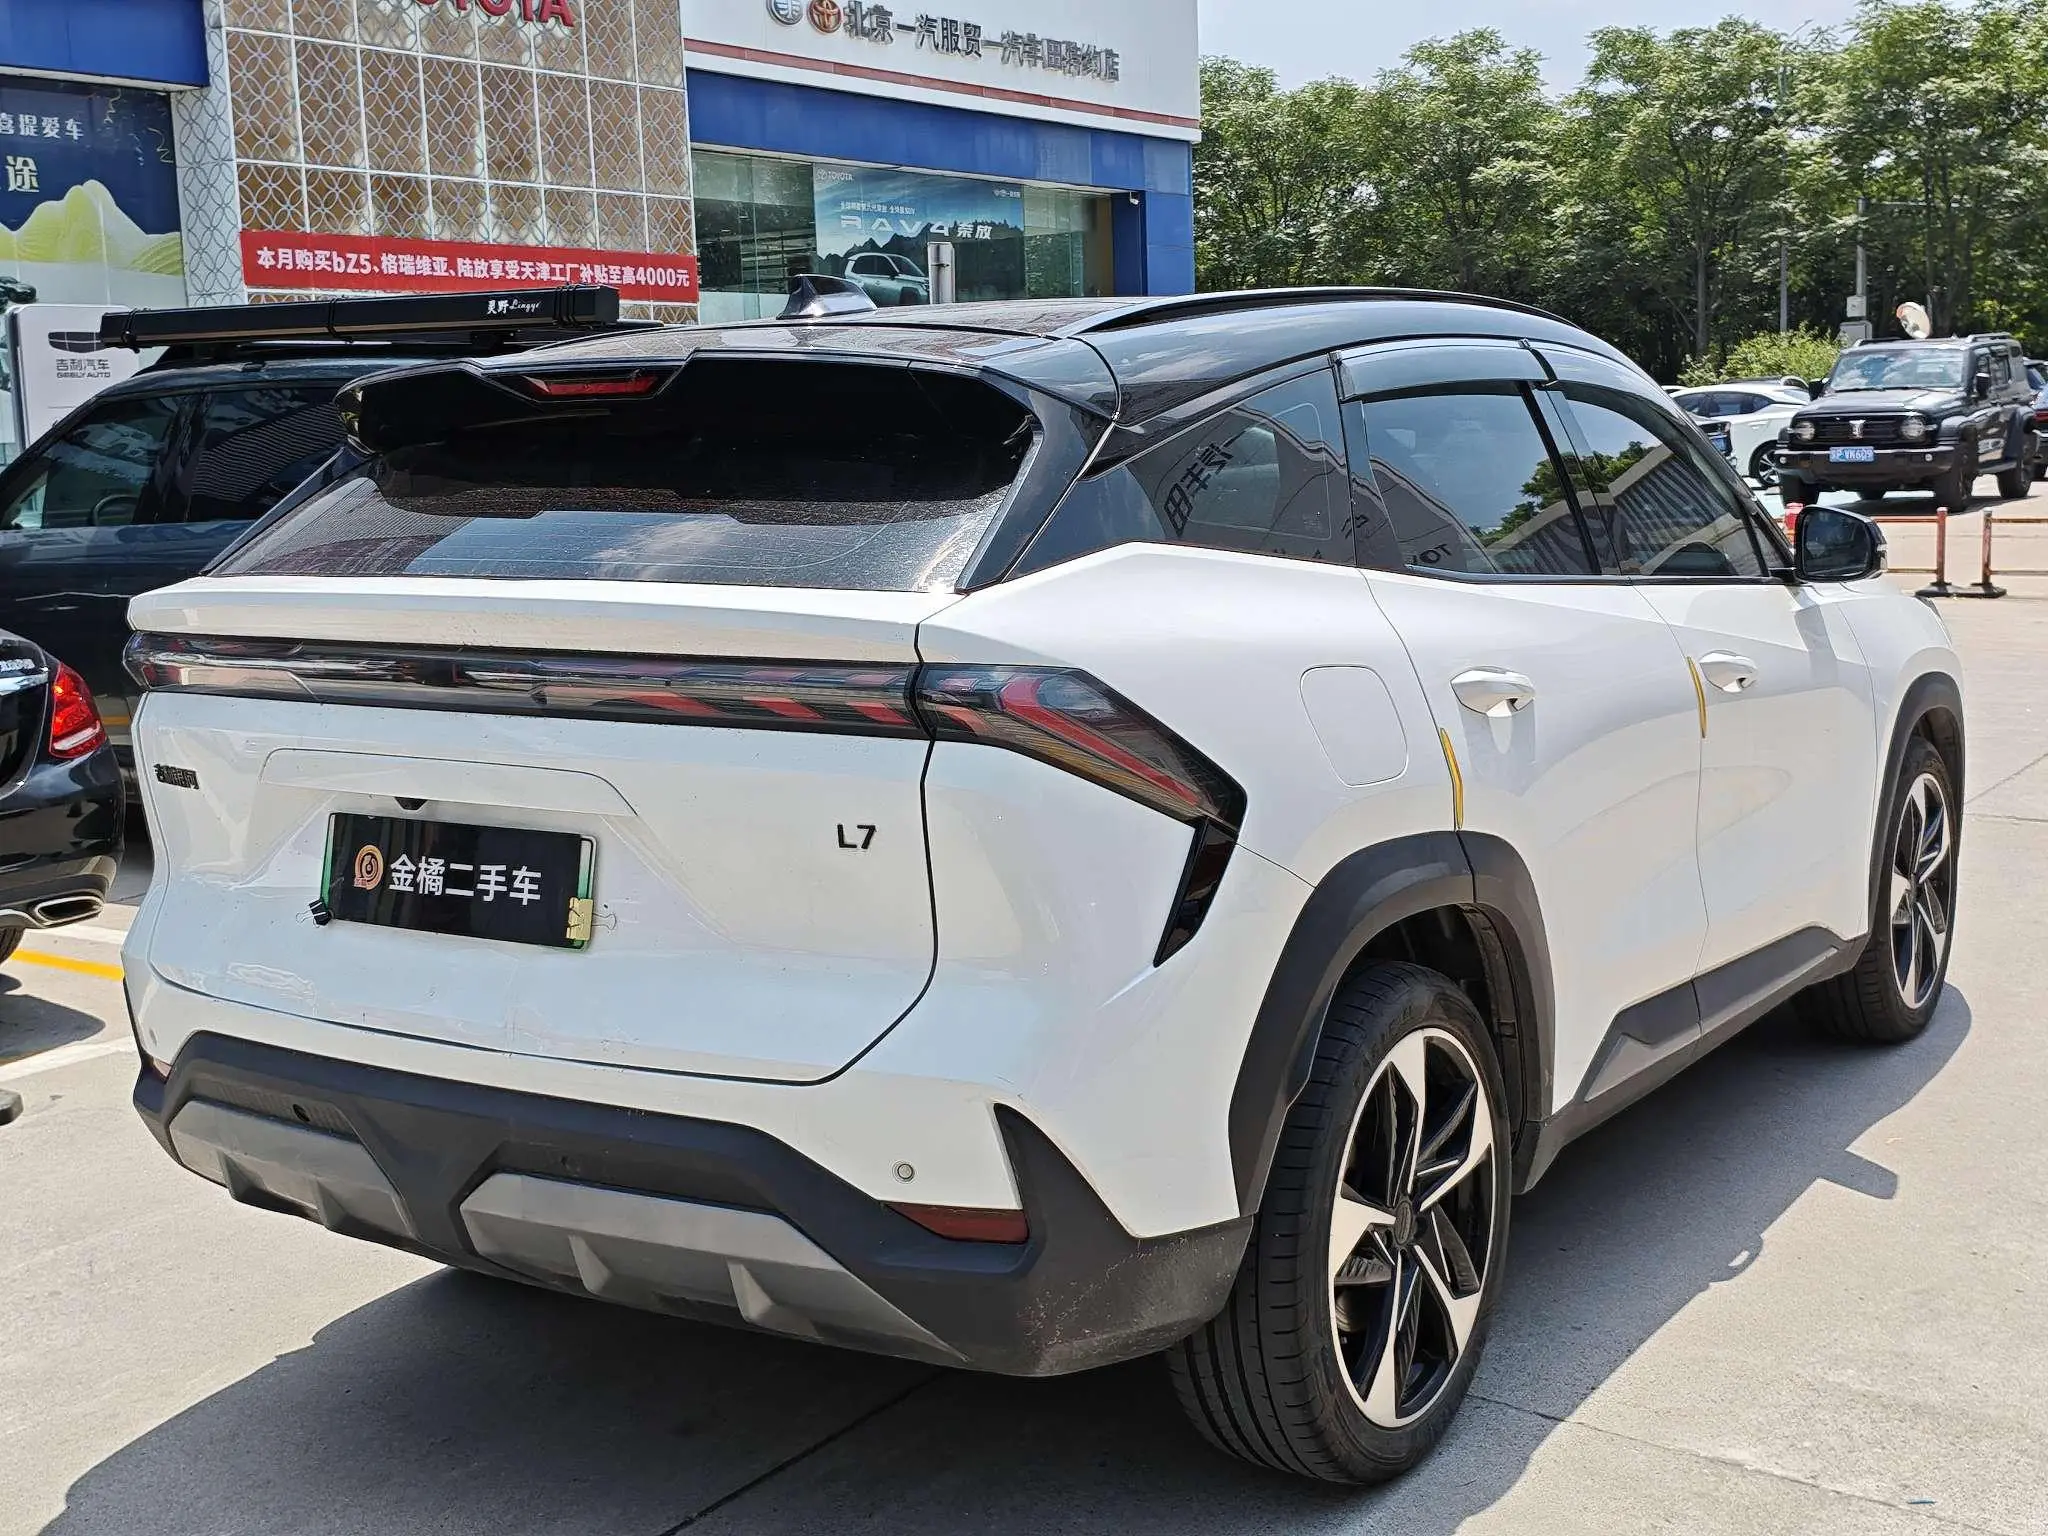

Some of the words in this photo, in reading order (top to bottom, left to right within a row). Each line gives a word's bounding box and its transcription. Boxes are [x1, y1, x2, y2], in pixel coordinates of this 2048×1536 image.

[56, 358, 110, 371] 吉利汽车
[56, 371, 85, 379] GEELY
[86, 371, 111, 379] AUTO
[837, 824, 877, 850] L7
[388, 853, 542, 906] 金橘二手车
